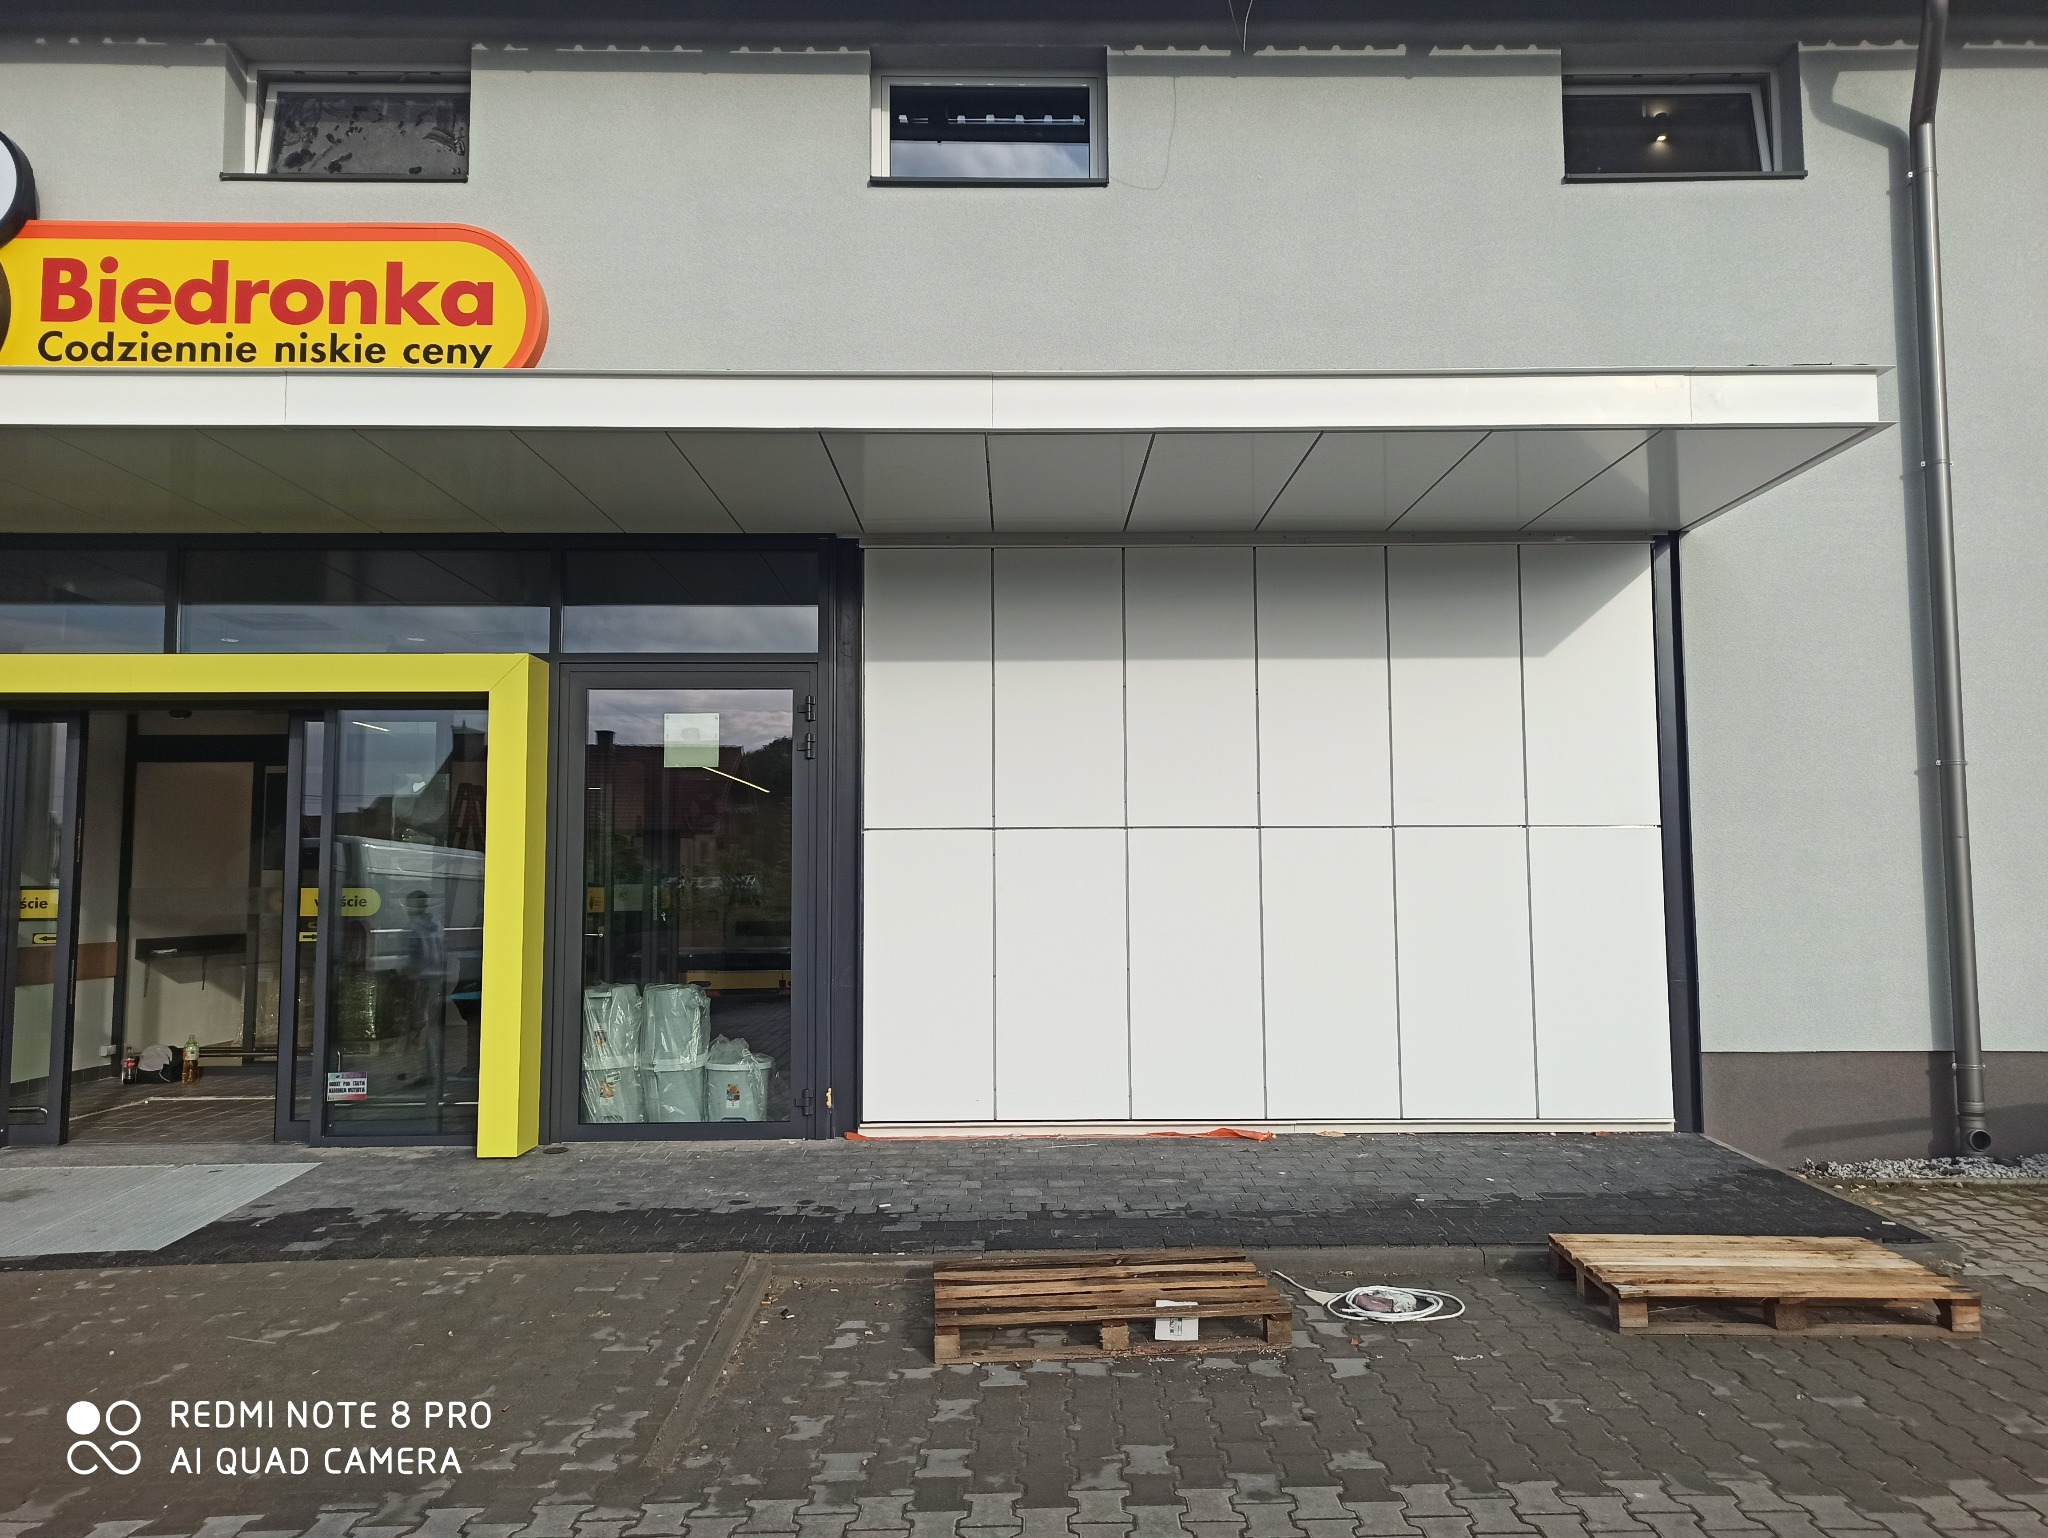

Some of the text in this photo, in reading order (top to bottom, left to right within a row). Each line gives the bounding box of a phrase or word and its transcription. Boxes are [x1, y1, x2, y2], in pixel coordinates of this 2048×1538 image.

[40, 256, 494, 327] Biedronka
[37, 330, 493, 368] Codziennie niskie ceny
[20, 897, 48, 909] ście
[314, 895, 368, 907] ście
